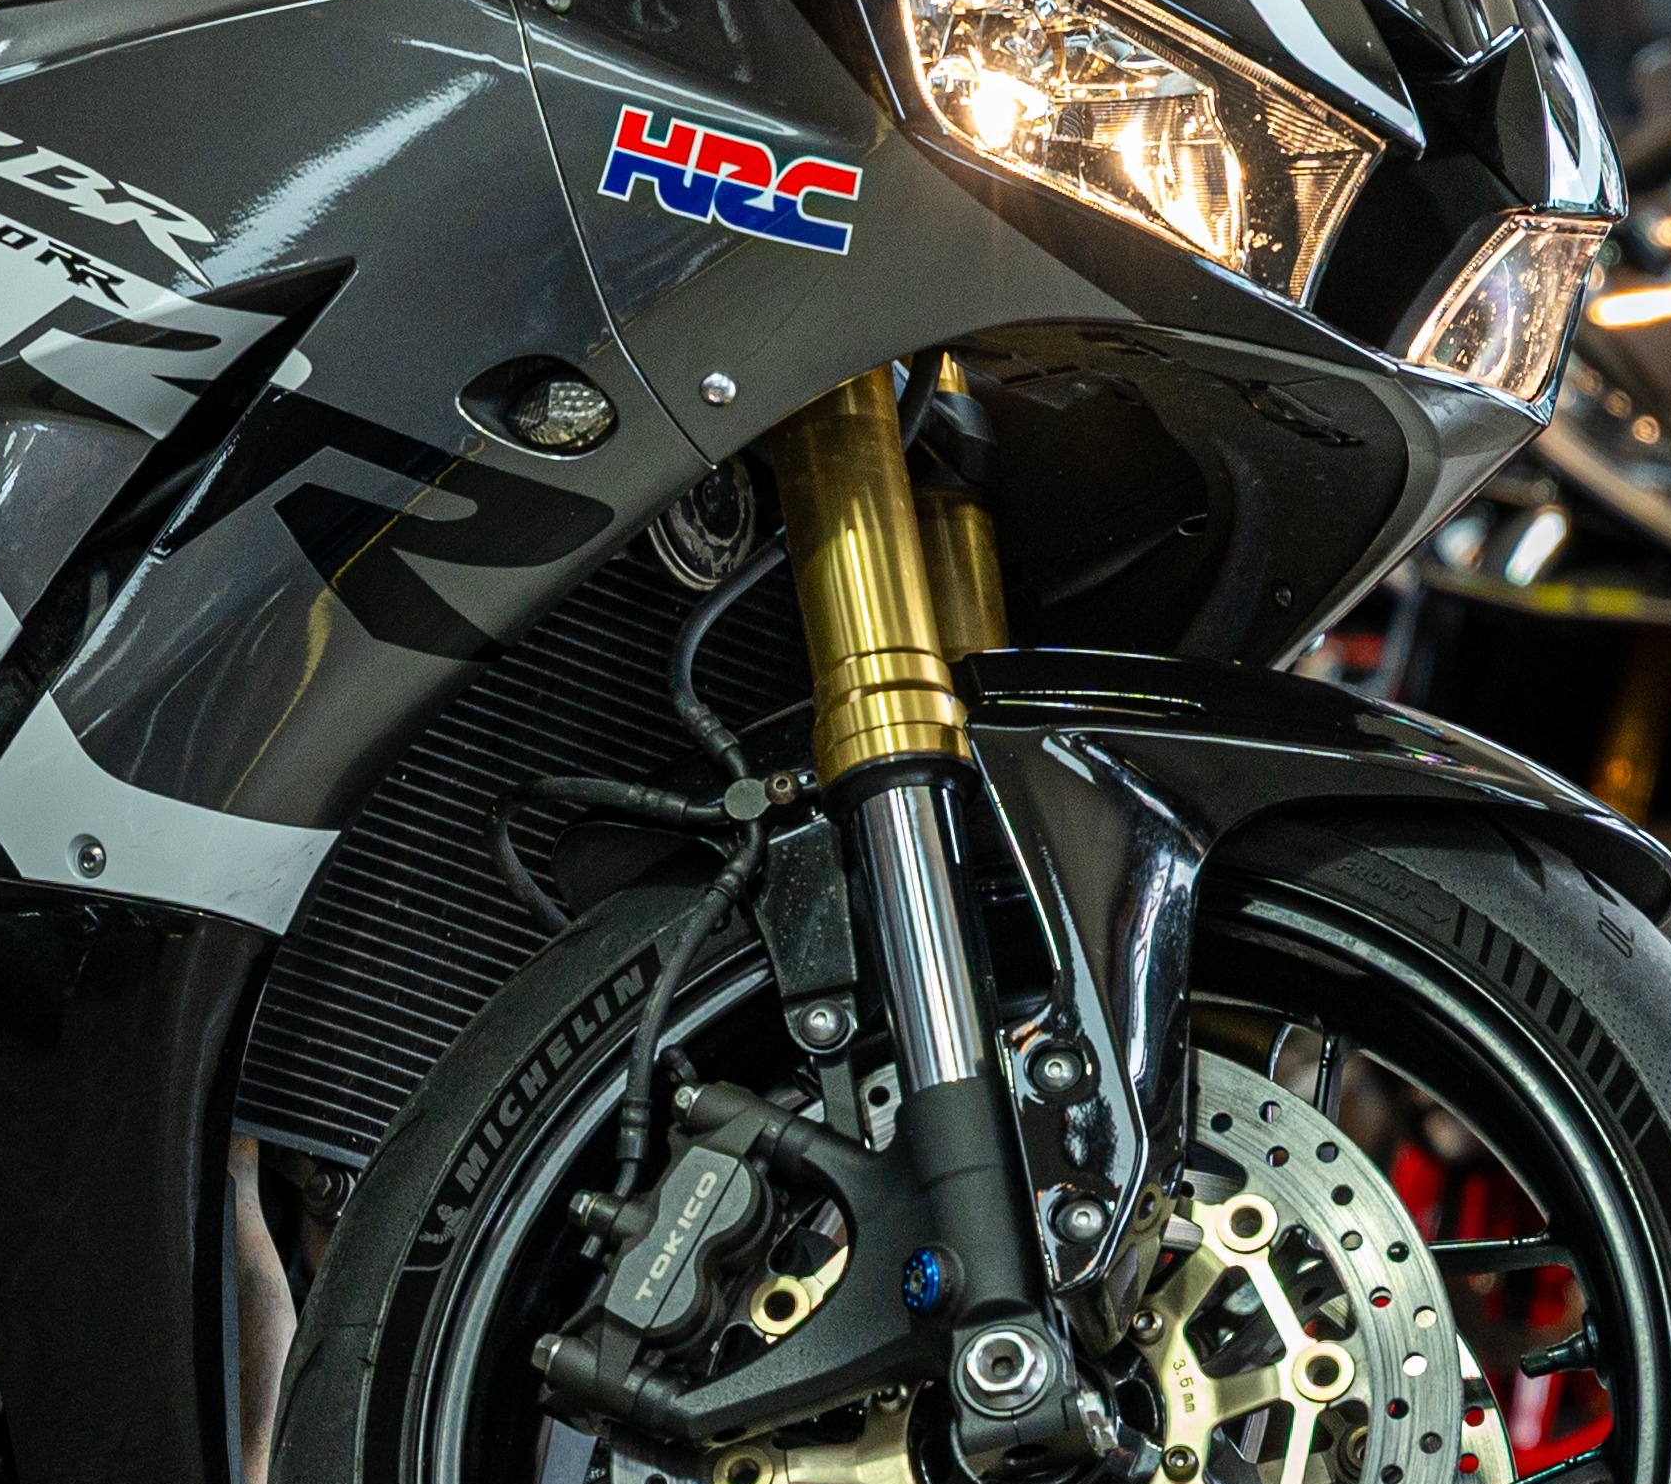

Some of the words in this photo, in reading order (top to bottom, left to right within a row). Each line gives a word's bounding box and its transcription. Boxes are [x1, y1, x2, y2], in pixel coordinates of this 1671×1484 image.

[597, 104, 863, 255] HRC
[1336, 857, 1419, 902] FRONT
[454, 964, 645, 1194] MICHELIN
[634, 1170, 719, 1302] TOKICO
